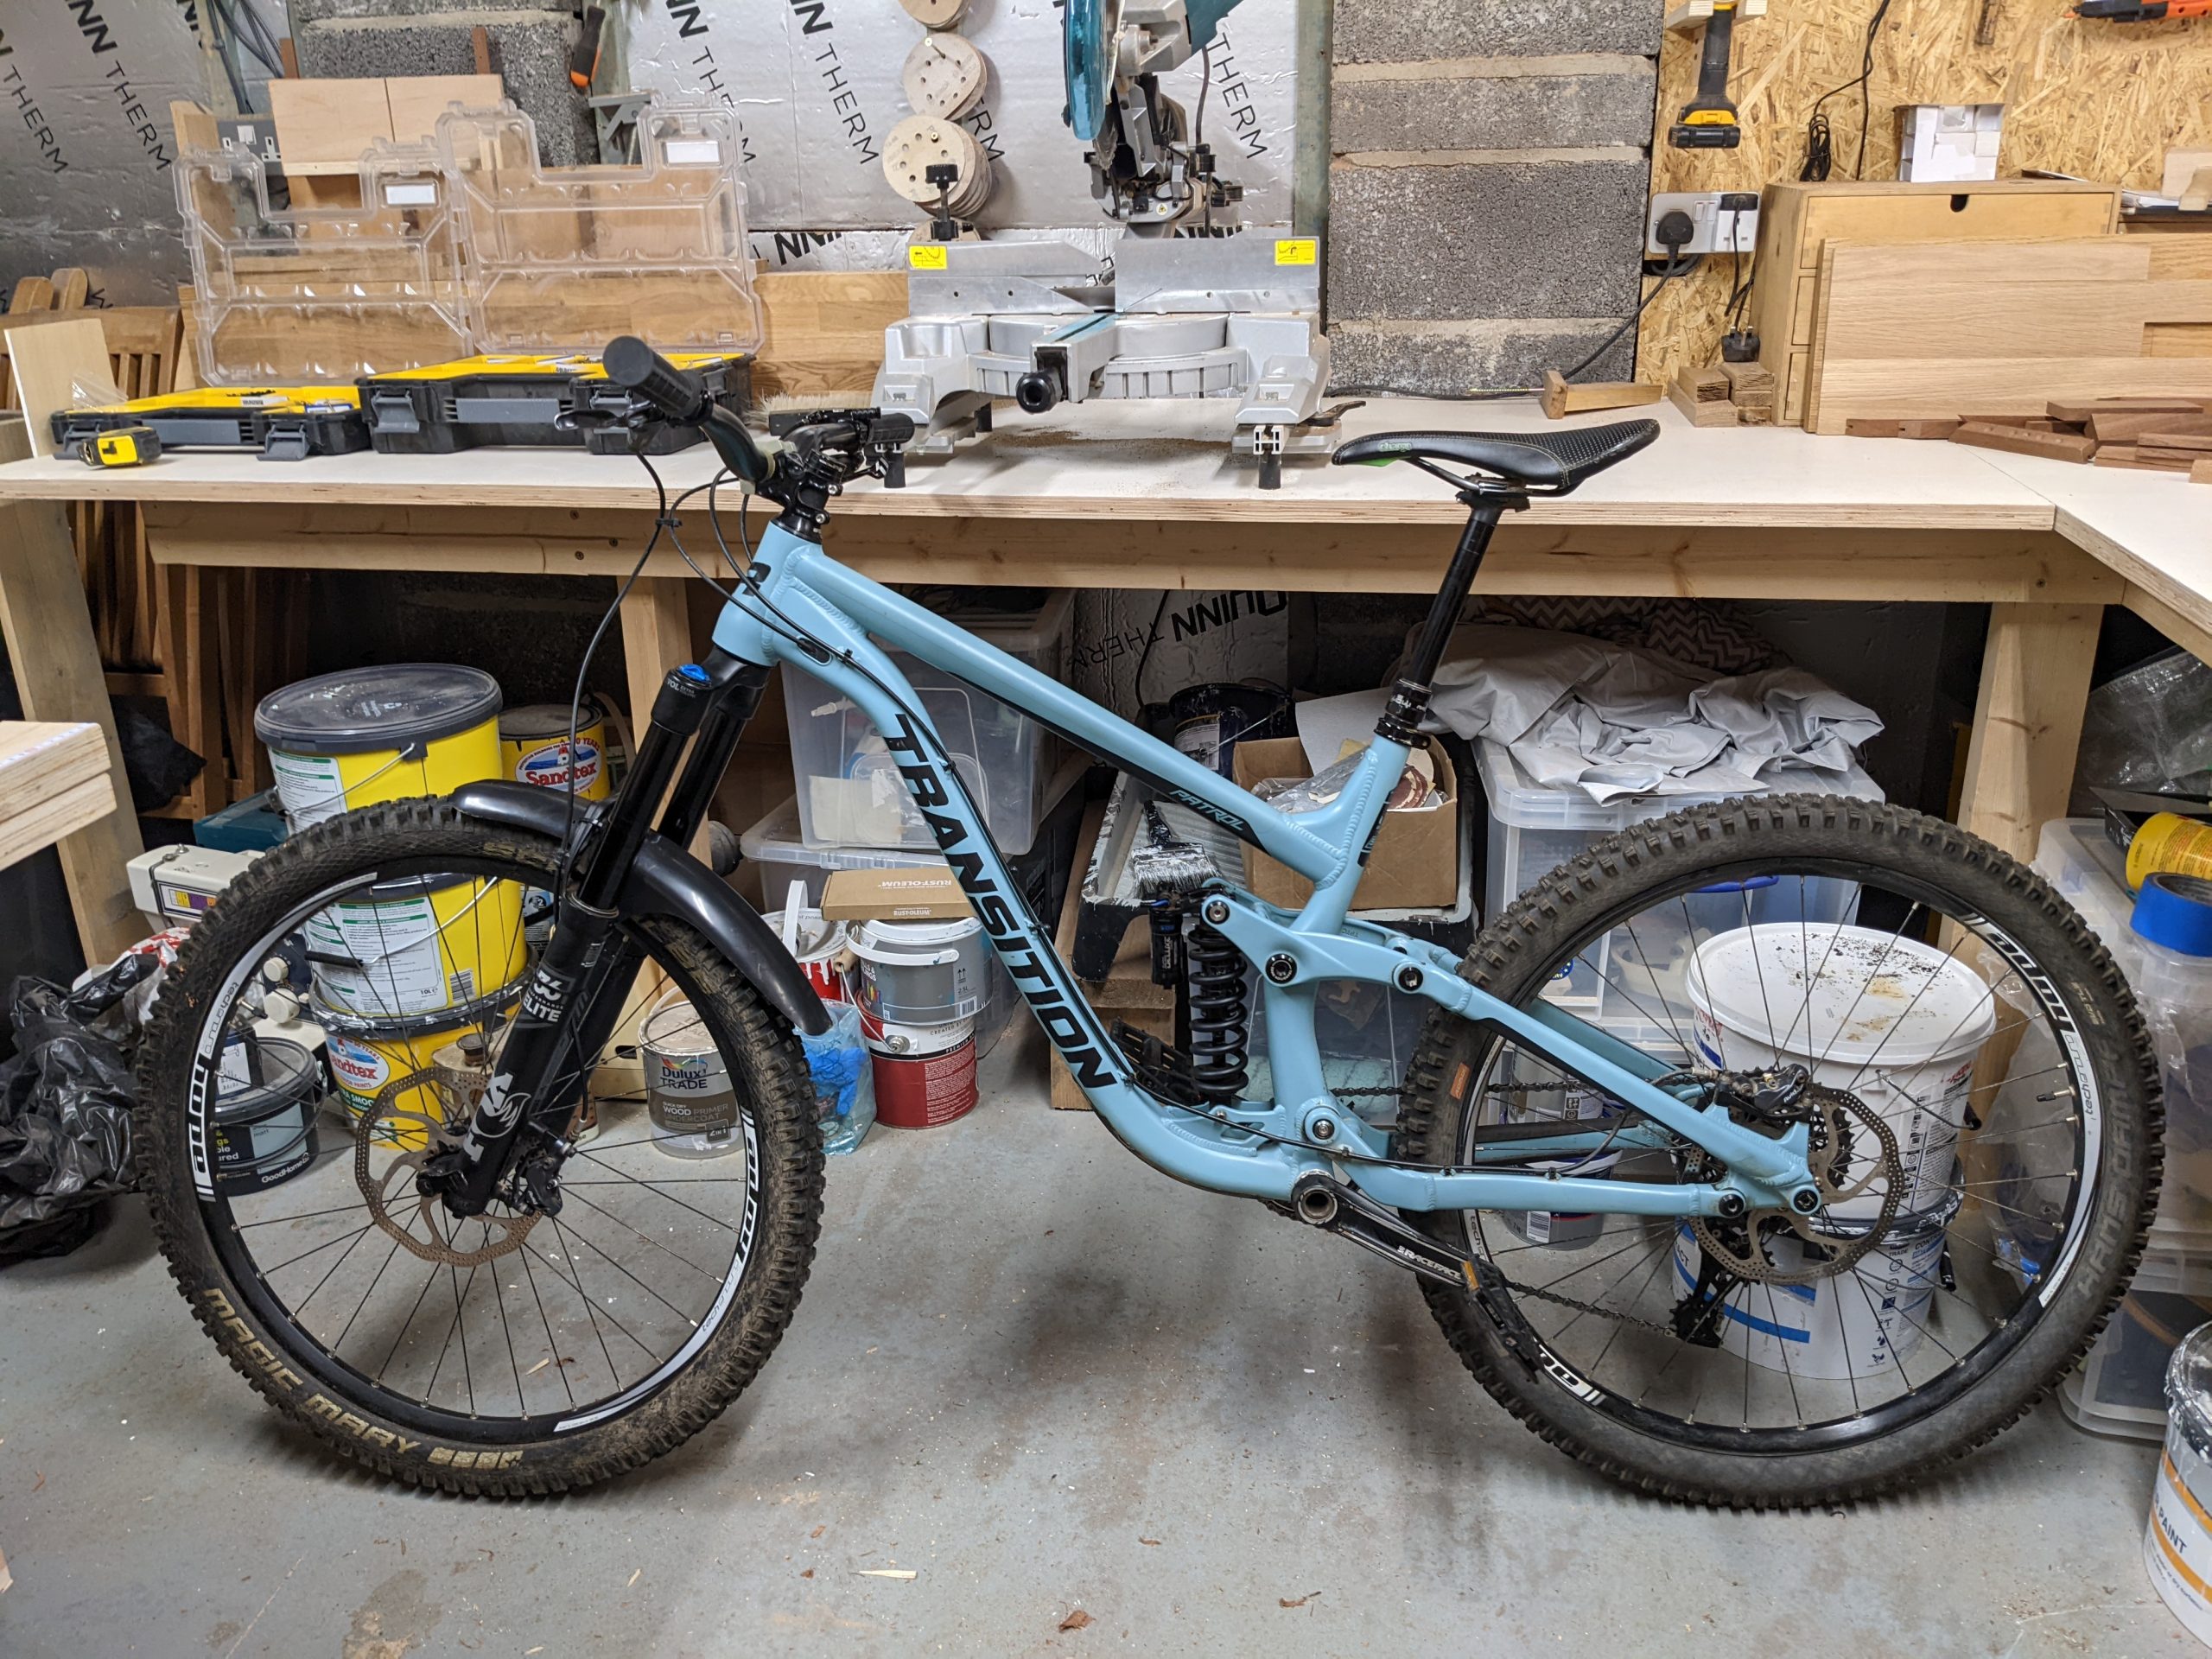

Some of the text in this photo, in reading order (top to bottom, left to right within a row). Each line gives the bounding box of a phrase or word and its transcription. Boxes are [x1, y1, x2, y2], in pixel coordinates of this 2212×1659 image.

[67, 0, 172, 171] NN THERM
[815, 42, 880, 164] THERM
[1206, 32, 1268, 159] THERM
[3, 64, 69, 174] THERM
[667, 677, 680, 691] VOL
[1169, 789, 1244, 831] PATROL
[883, 713, 1117, 1089] TRANSITION
[523, 994, 563, 1023] ELITE
[330, 1054, 378, 1080] andtex
[659, 1077, 708, 1090] TRADE
[661, 1066, 702, 1079] Dulux
[663, 1103, 729, 1116] WOOD PRIMER
[261, 1159, 303, 1184] GoodHome
[204, 1288, 423, 1454] MAGIC MARY
[2158, 1506, 2189, 1554] PAINT
